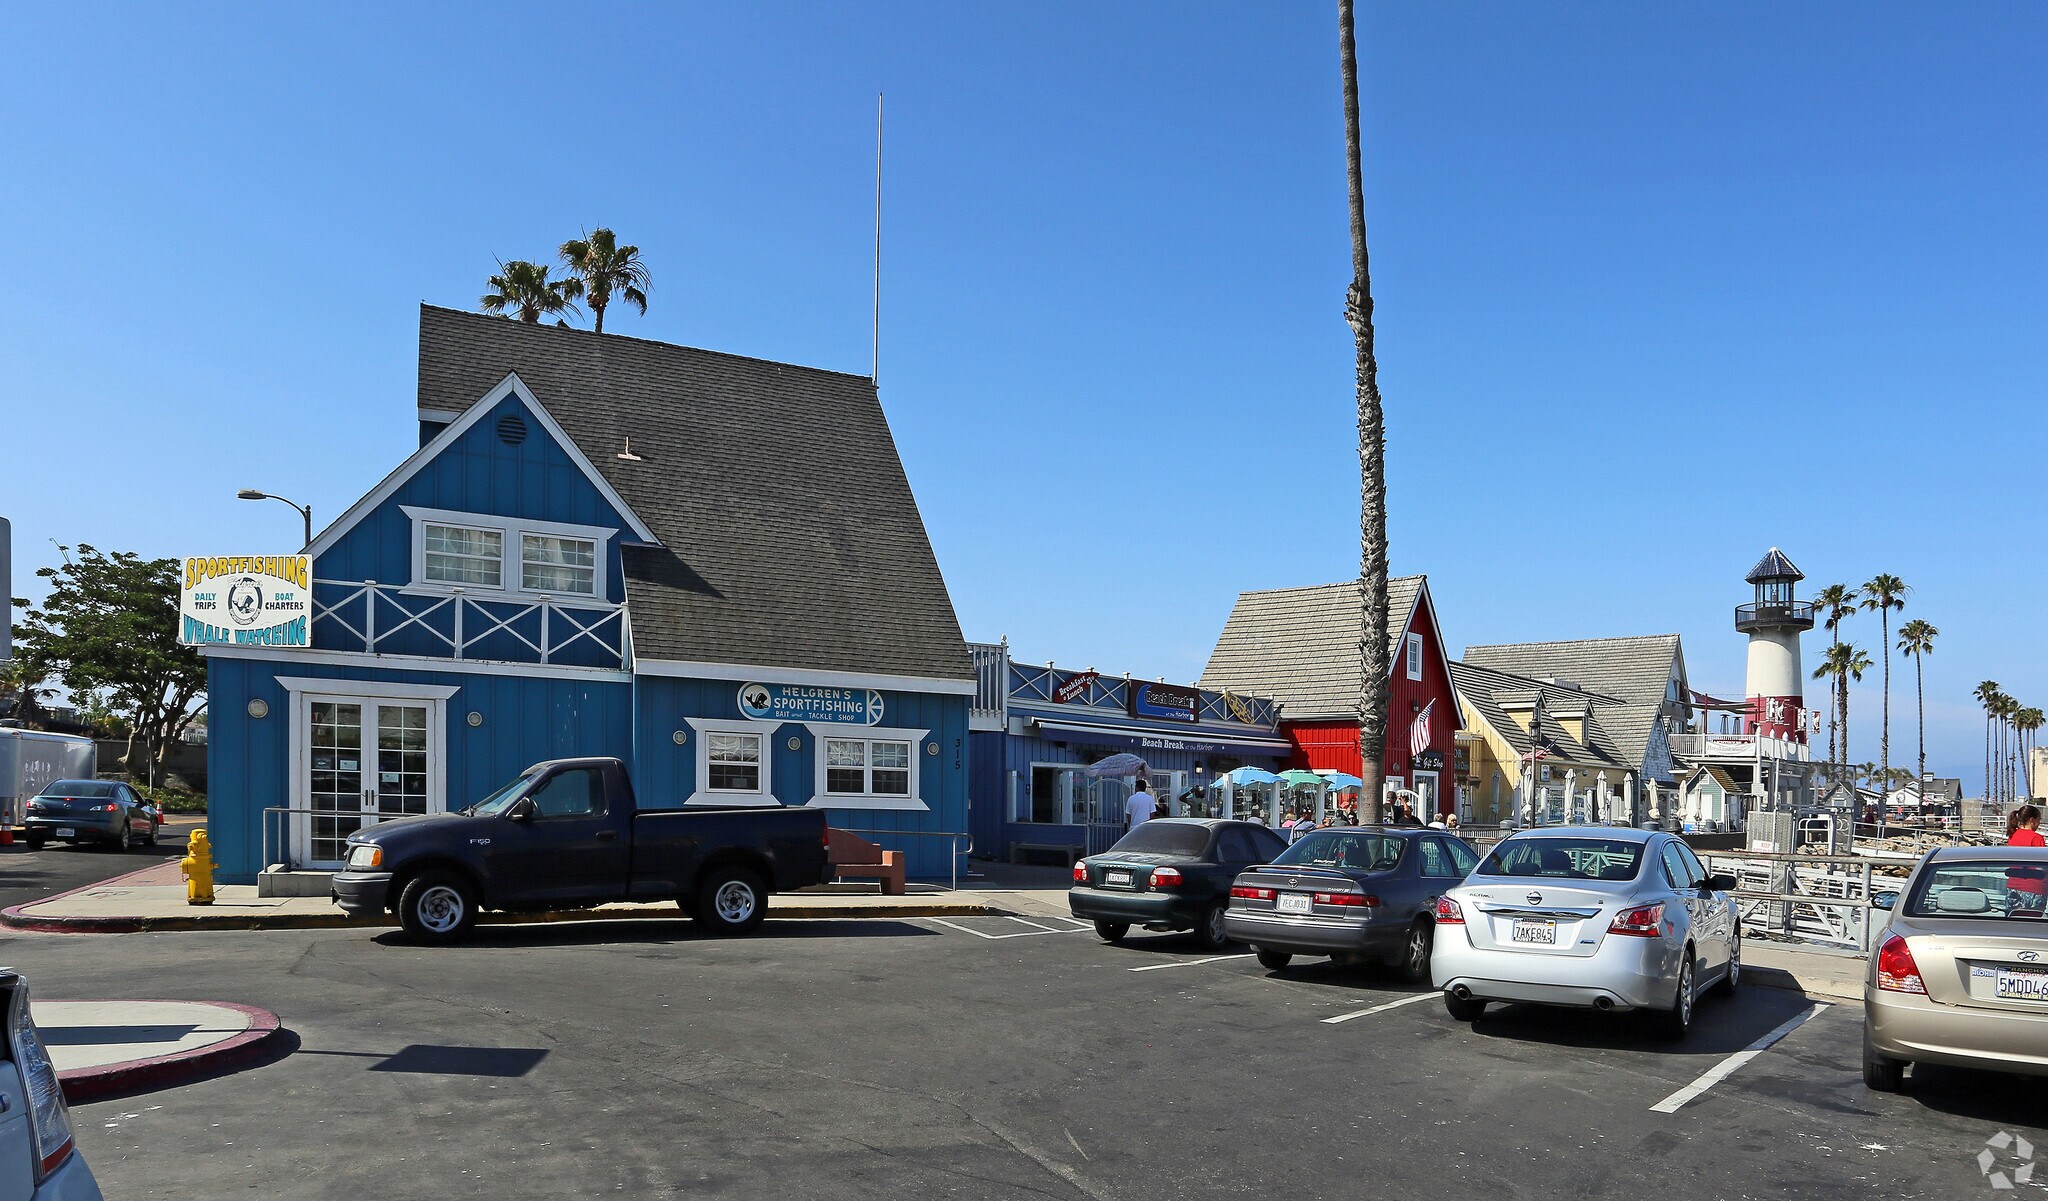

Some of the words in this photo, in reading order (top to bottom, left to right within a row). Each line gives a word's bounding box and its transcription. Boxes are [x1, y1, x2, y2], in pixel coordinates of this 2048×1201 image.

[185, 556, 308, 590] SPORTFISHING
[195, 592, 217, 601] DAILY
[275, 592, 294, 601] BOAT
[195, 601, 217, 610] TRIPS
[265, 601, 304, 611] CHARTERS
[183, 613, 230, 644] WHALE
[235, 614, 307, 646] WATCHING
[1059, 675, 1086, 696] Breakfast
[782, 686, 852, 700] HELGREN'S
[1067, 686, 1084, 700] Lunch
[1146, 690, 1168, 704] Beach
[1168, 693, 1190, 707] Break
[773, 697, 863, 713] SPORTFISHING
[775, 710, 790, 718] BAIT
[808, 712, 833, 720] TACKLE
[838, 713, 855, 721] SHOP
[1141, 737, 1163, 748] Beach
[1164, 739, 1185, 750] Break
[1196, 743, 1214, 752] Harbor
[1423, 757, 1432, 769] Gift
[1433, 757, 1444, 769] Shop
[1515, 926, 1553, 941] 7AKE845
[1972, 969, 1994, 977] ALOHA
